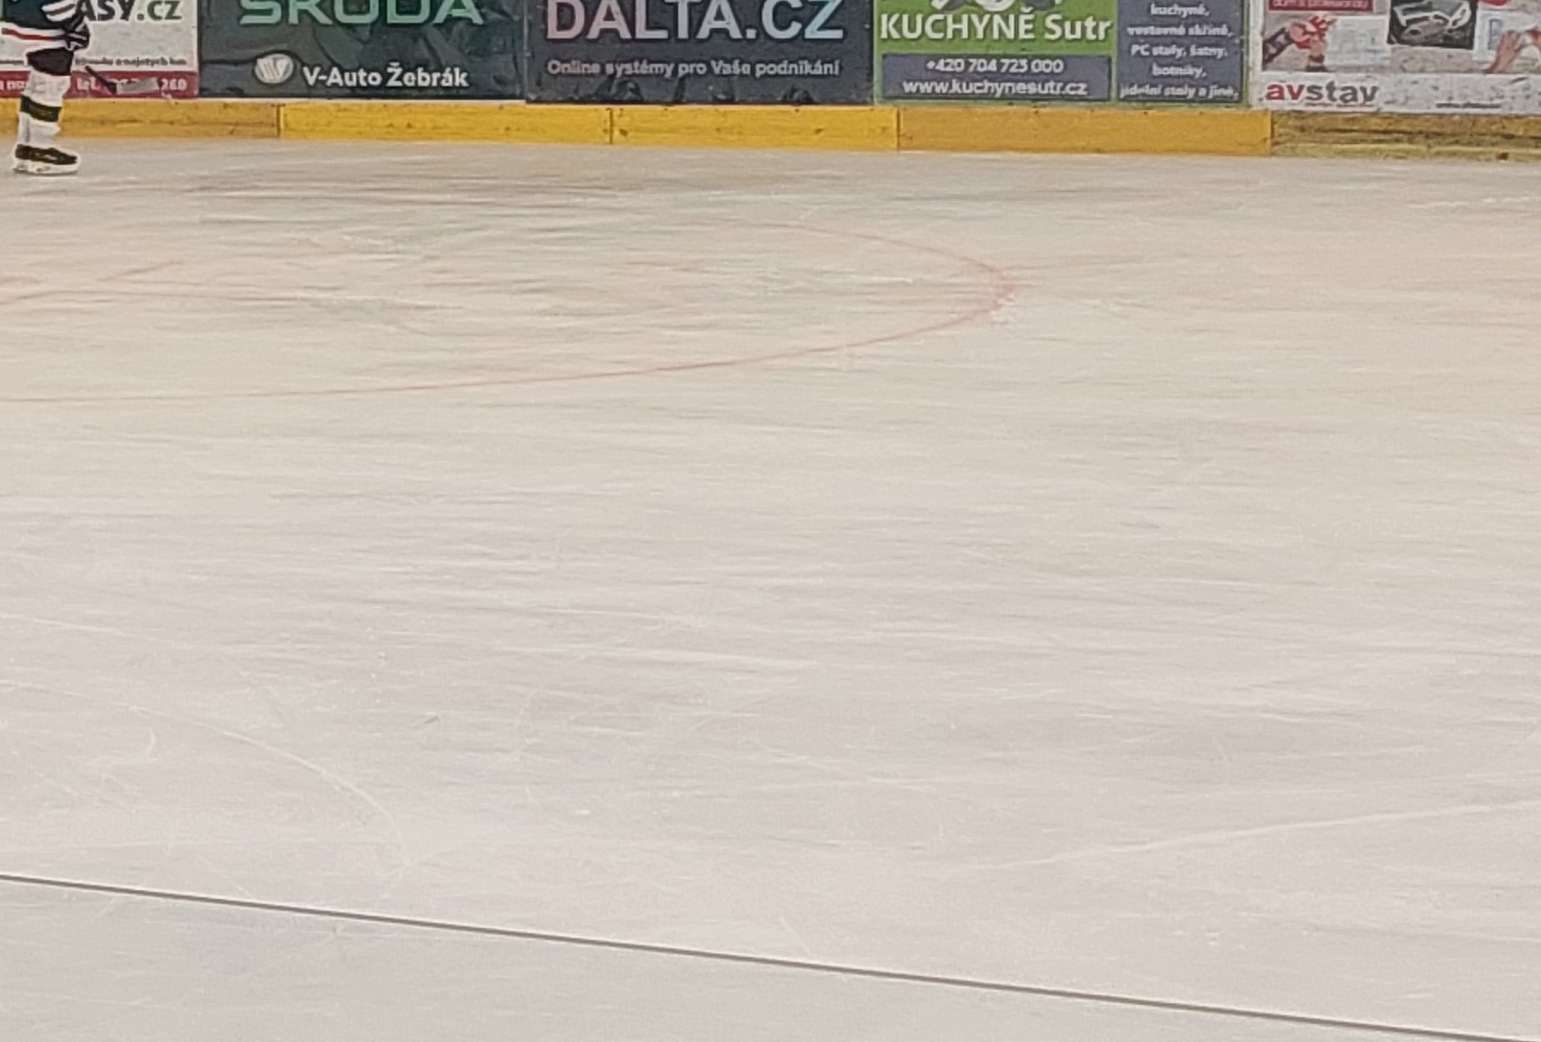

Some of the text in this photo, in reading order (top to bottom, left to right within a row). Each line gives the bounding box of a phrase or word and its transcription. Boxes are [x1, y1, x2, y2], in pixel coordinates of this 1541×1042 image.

[880, 6, 1113, 41] KUCHYNĚ Sutr
[303, 62, 469, 87] V-Auto Žebrák
[547, 59, 840, 79] Online systémy pro Vaše podnikání
[926, 59, 964, 72] +420
[969, 59, 997, 72] 704
[1031, 59, 1064, 73] 000
[903, 79, 1088, 98] www.kuchynesutr.cz
[1265, 79, 1378, 103] avstav
